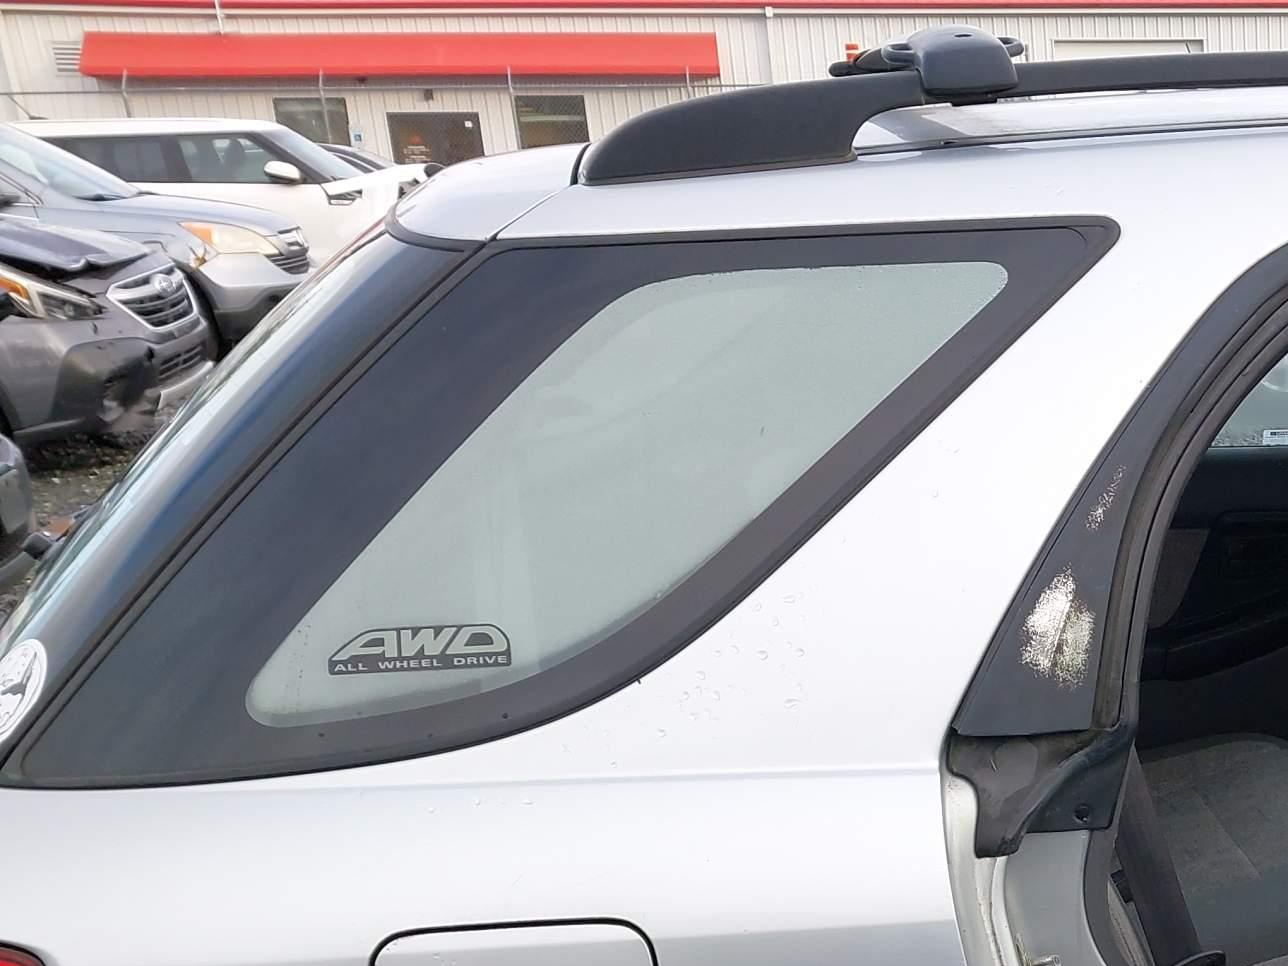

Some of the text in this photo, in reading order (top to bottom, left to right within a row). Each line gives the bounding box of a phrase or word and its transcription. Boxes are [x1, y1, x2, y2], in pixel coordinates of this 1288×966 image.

[331, 626, 508, 661] AWD
[334, 655, 508, 672] ALL WHEEL DRIVE
